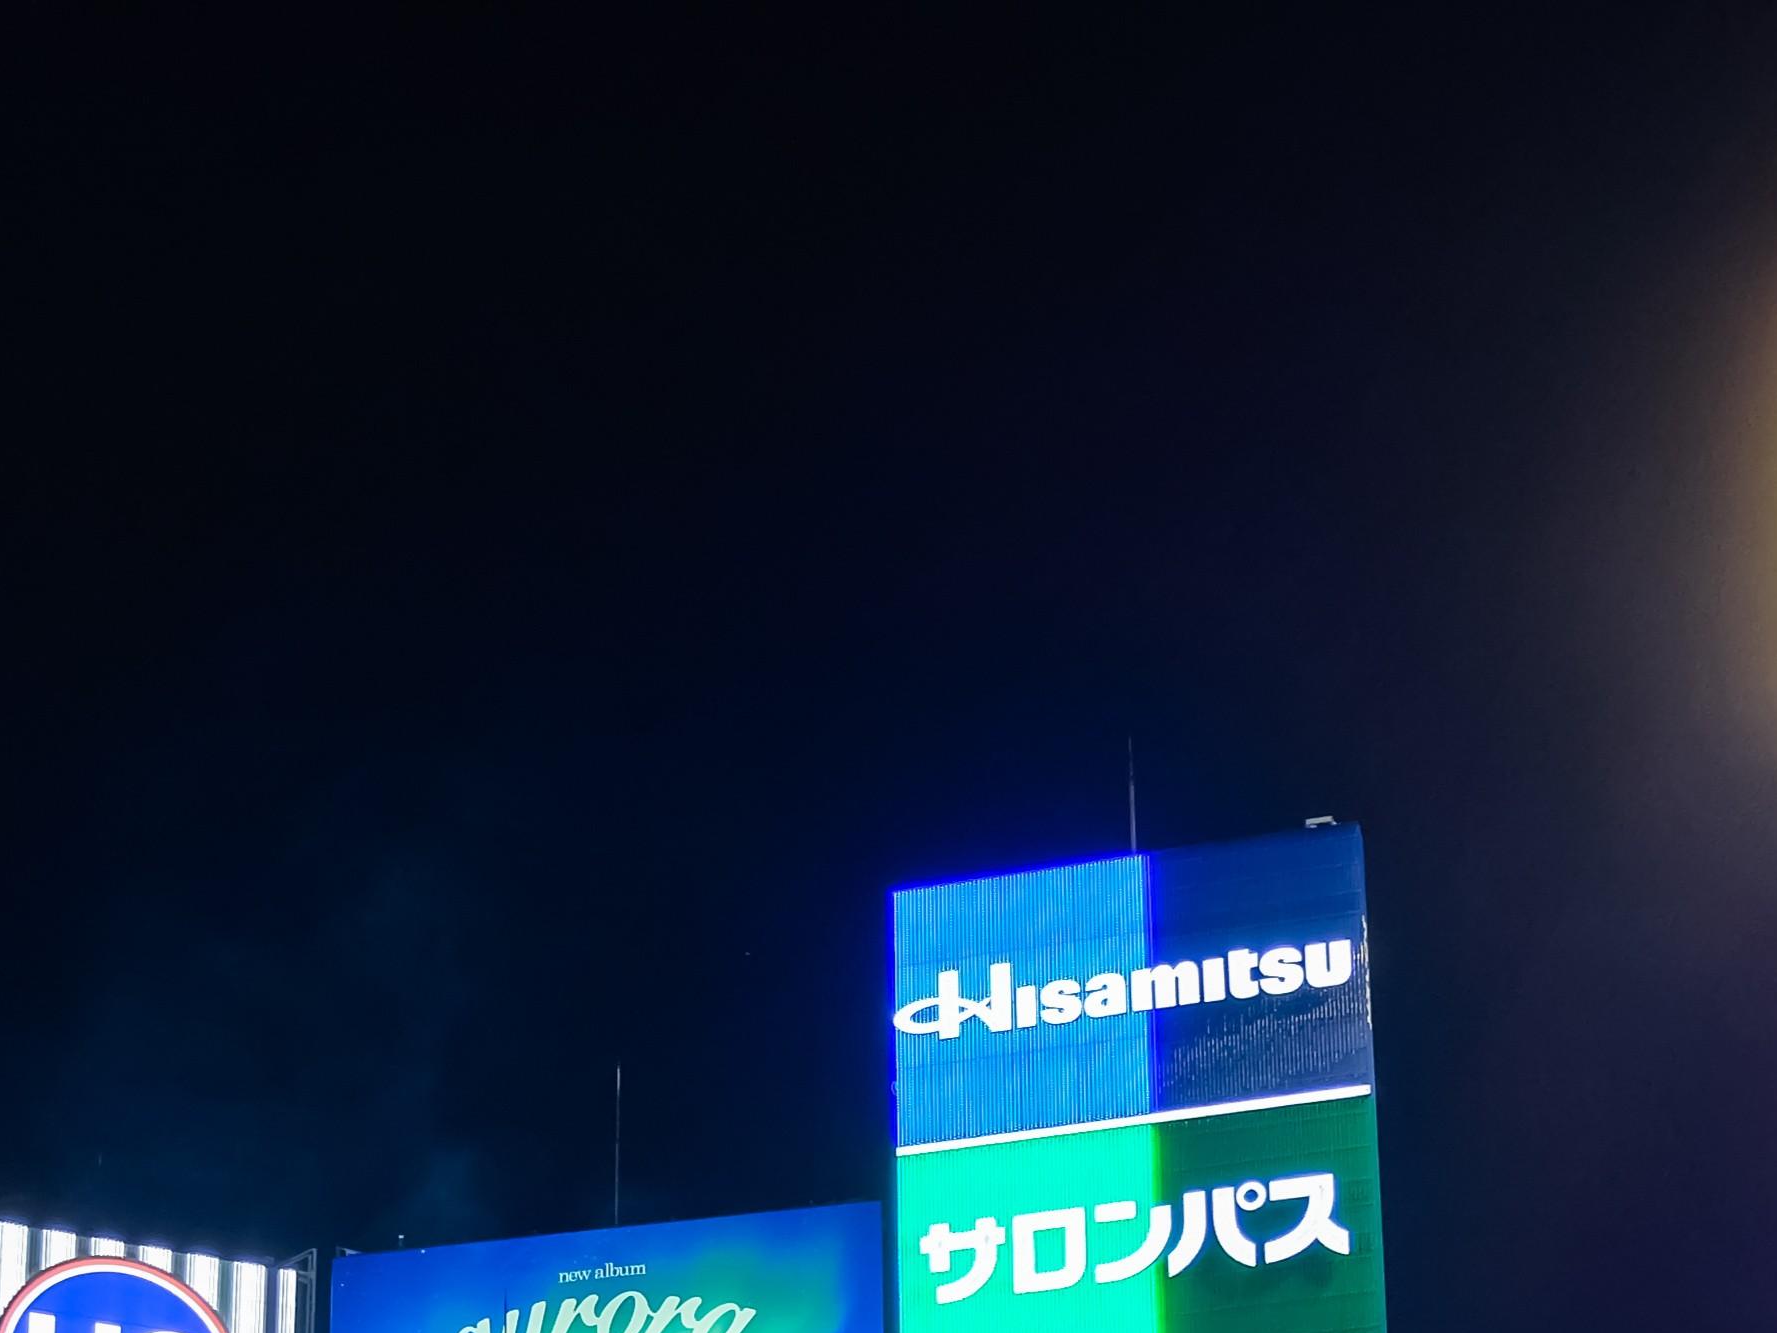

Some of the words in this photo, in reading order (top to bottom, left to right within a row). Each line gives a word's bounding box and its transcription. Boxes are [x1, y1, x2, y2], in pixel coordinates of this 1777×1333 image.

[893, 937, 1352, 1041] Hisamitsu
[558, 1266, 591, 1284] new
[594, 1260, 647, 1281] album
[920, 1172, 1350, 1304] サロンパス
